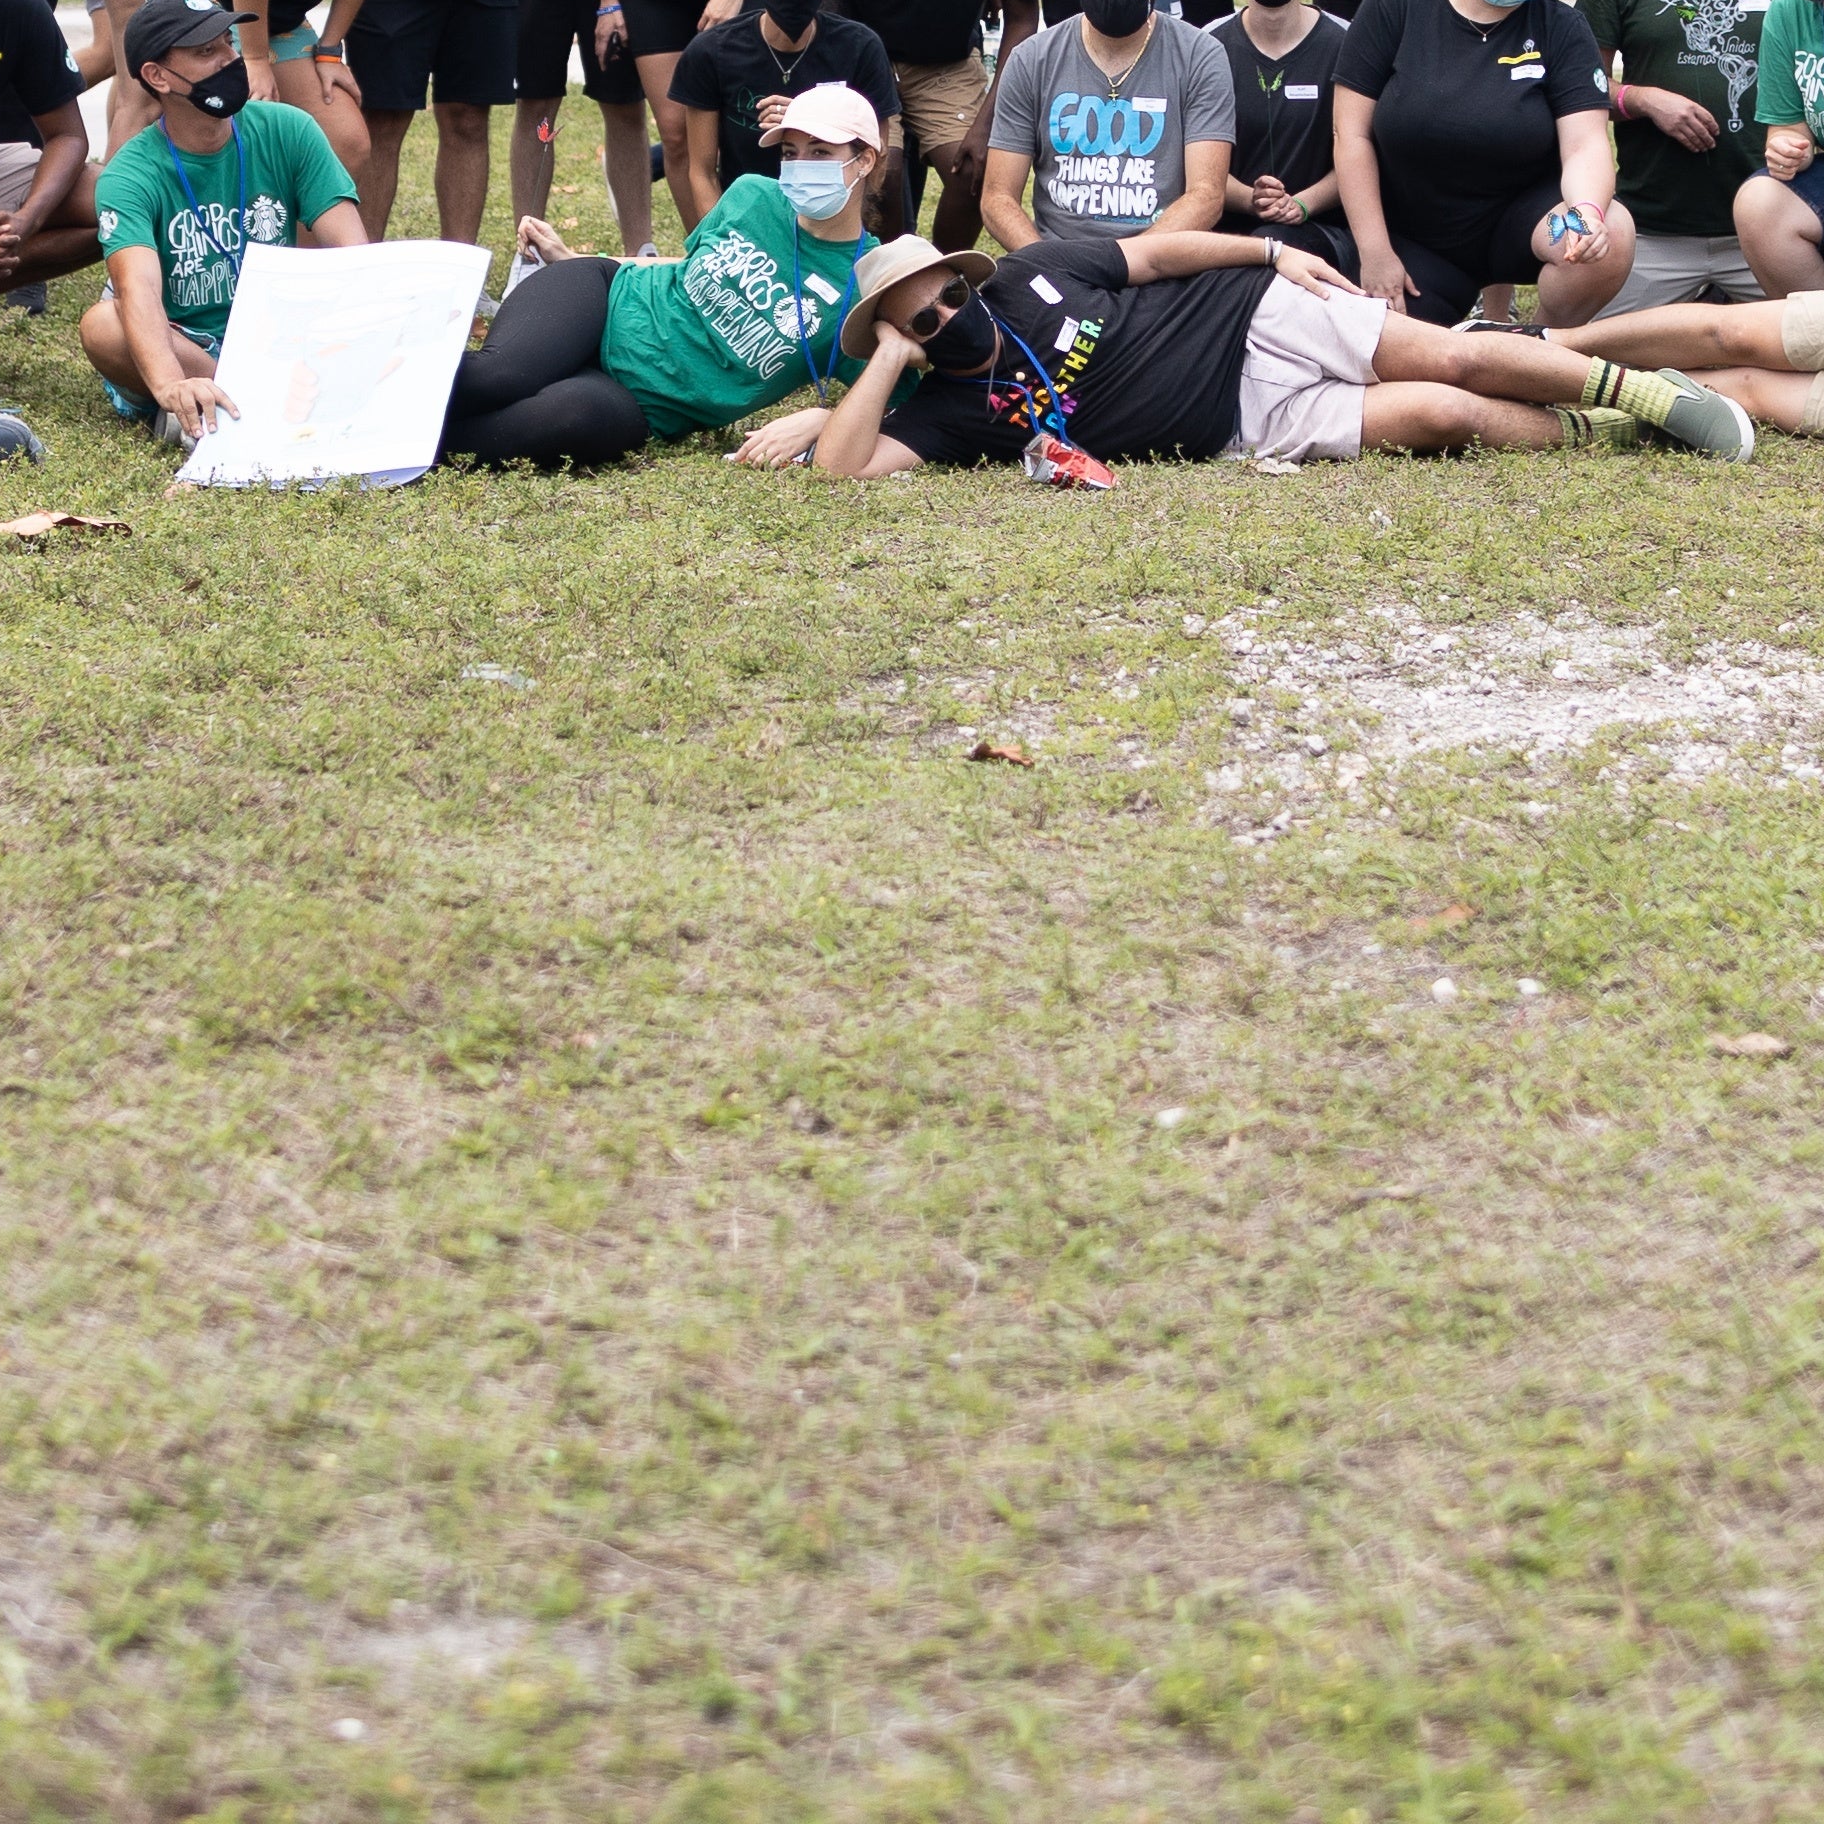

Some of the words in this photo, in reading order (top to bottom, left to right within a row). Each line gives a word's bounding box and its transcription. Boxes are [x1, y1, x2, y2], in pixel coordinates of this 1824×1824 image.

[1677, 52, 1716, 66] Estamos
[1721, 35, 1756, 54] Unidos
[1049, 91, 1165, 156] GOOD
[1054, 156, 1120, 184] THINGS
[1121, 157, 1156, 185] ARE
[1047, 179, 1159, 217] HAPPENING
[170, 256, 207, 279] ARE
[701, 252, 728, 285] ARE
[683, 256, 798, 381] HAPPENING
